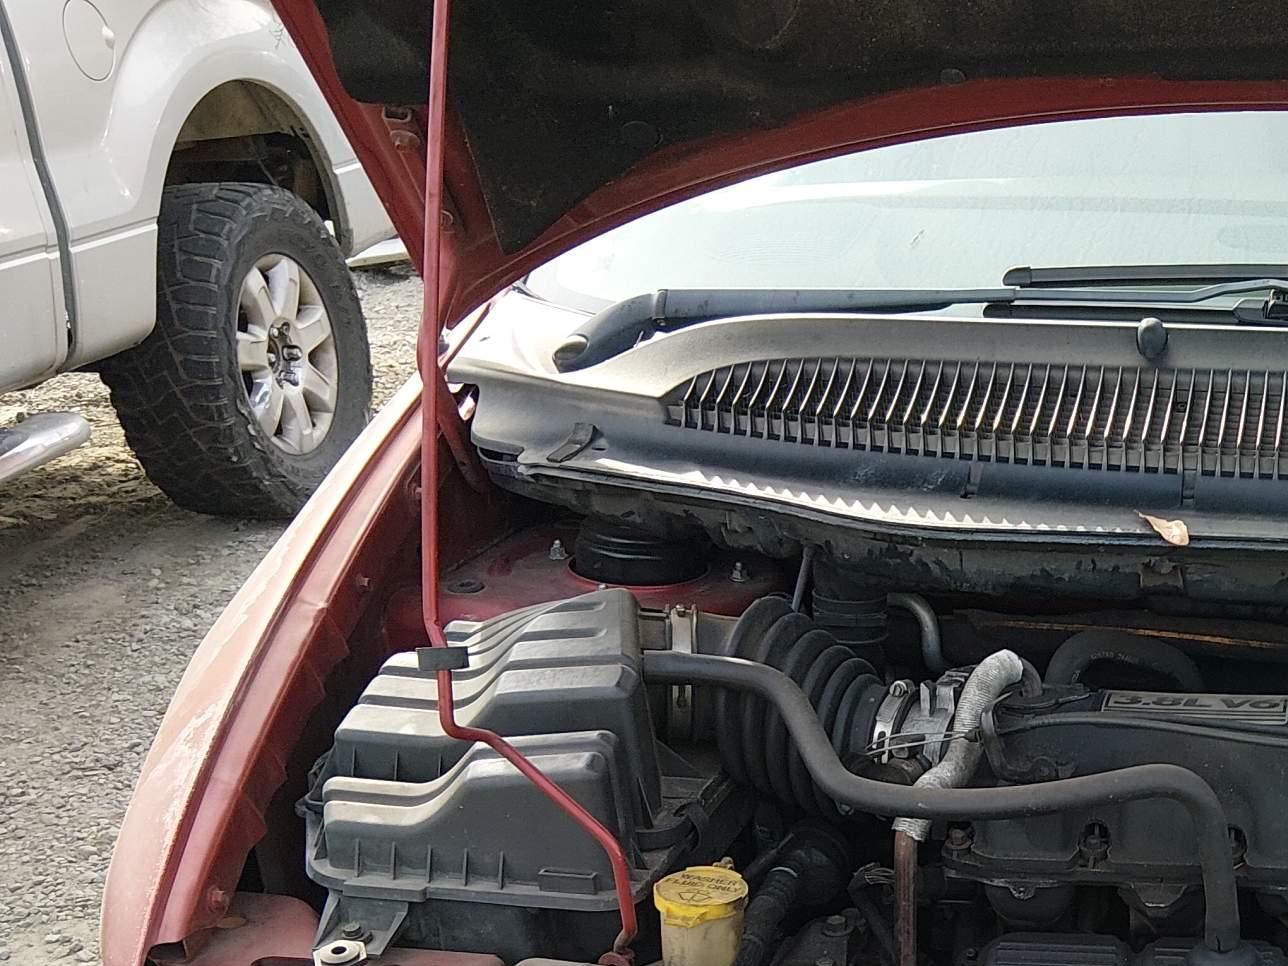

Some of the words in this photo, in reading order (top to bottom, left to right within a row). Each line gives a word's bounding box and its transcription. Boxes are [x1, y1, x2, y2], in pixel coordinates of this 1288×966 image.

[664, 877, 704, 888] FLUID
[707, 883, 741, 892] ONLY
[681, 873, 737, 886] WASHER
